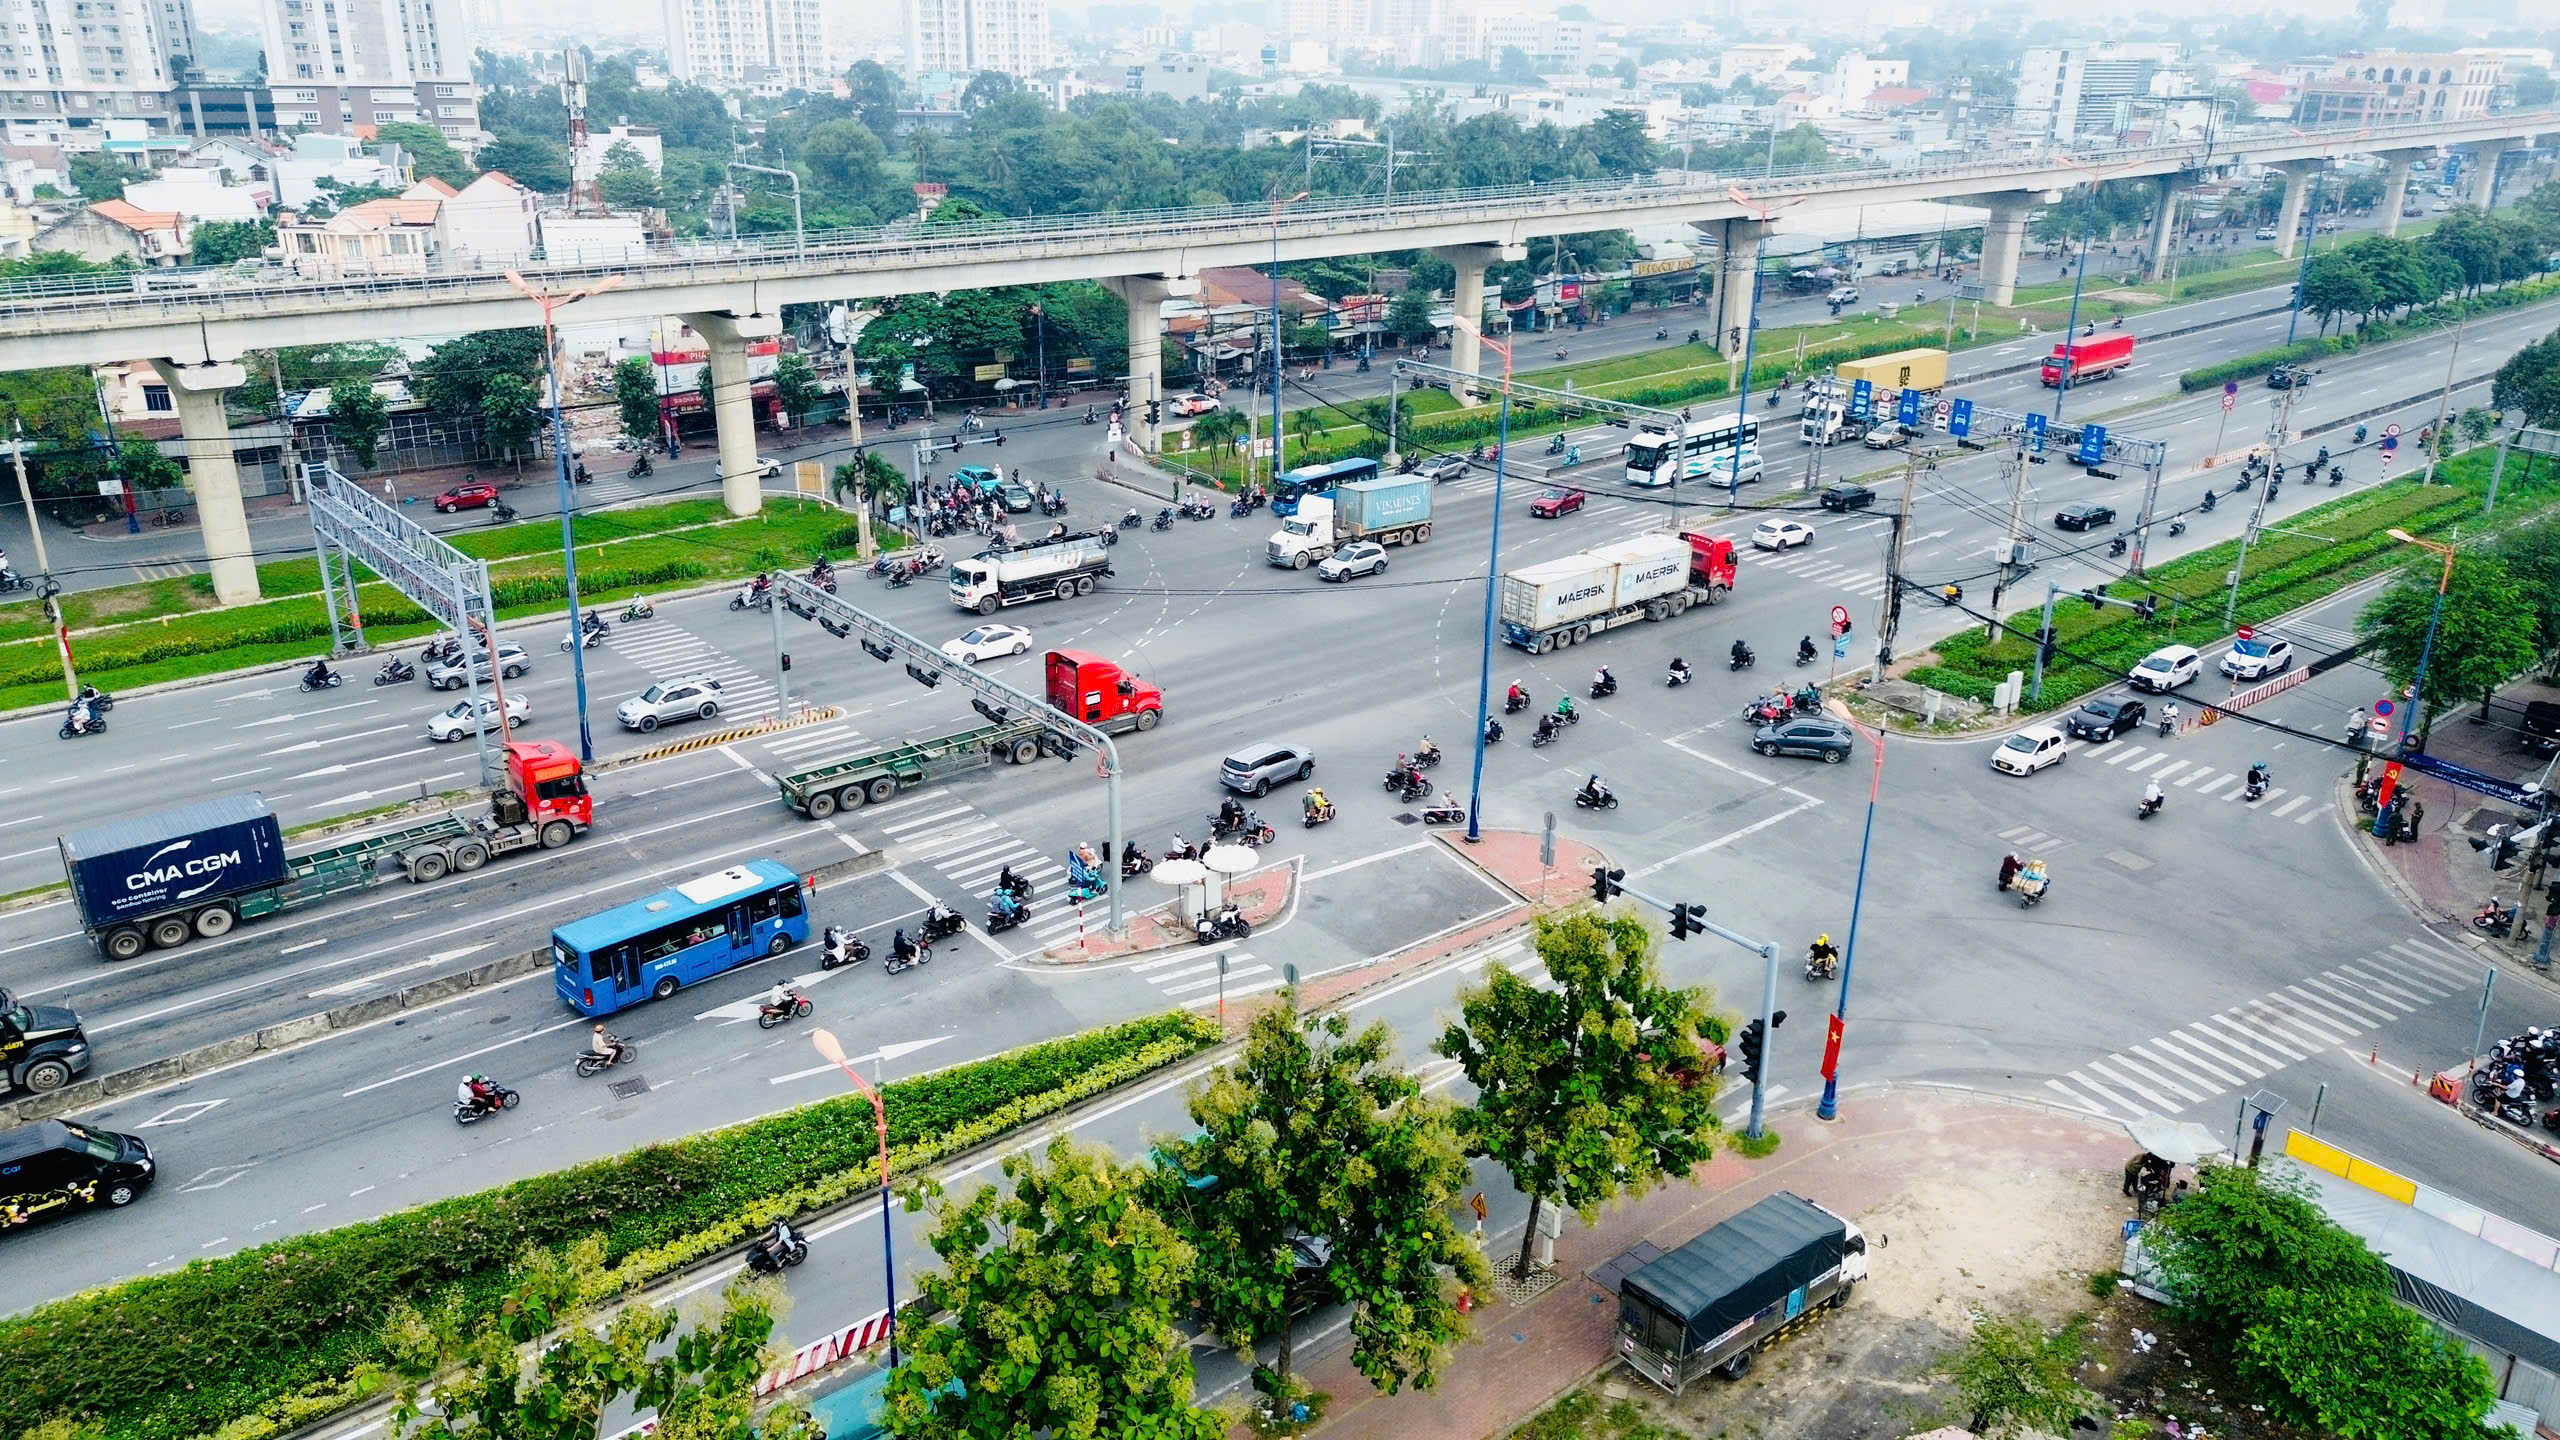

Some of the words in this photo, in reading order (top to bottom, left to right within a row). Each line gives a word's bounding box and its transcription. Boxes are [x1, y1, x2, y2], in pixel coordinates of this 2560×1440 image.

[1376, 495, 1421, 511] VINALINES
[1635, 562, 1680, 584] MAERSK
[1557, 583, 1605, 606] MAERSK
[126, 864, 183, 890] CMA
[185, 850, 241, 876] CGM
[111, 897, 128, 906] eco
[128, 887, 168, 901] container
[2, 1164, 22, 1175] Car
